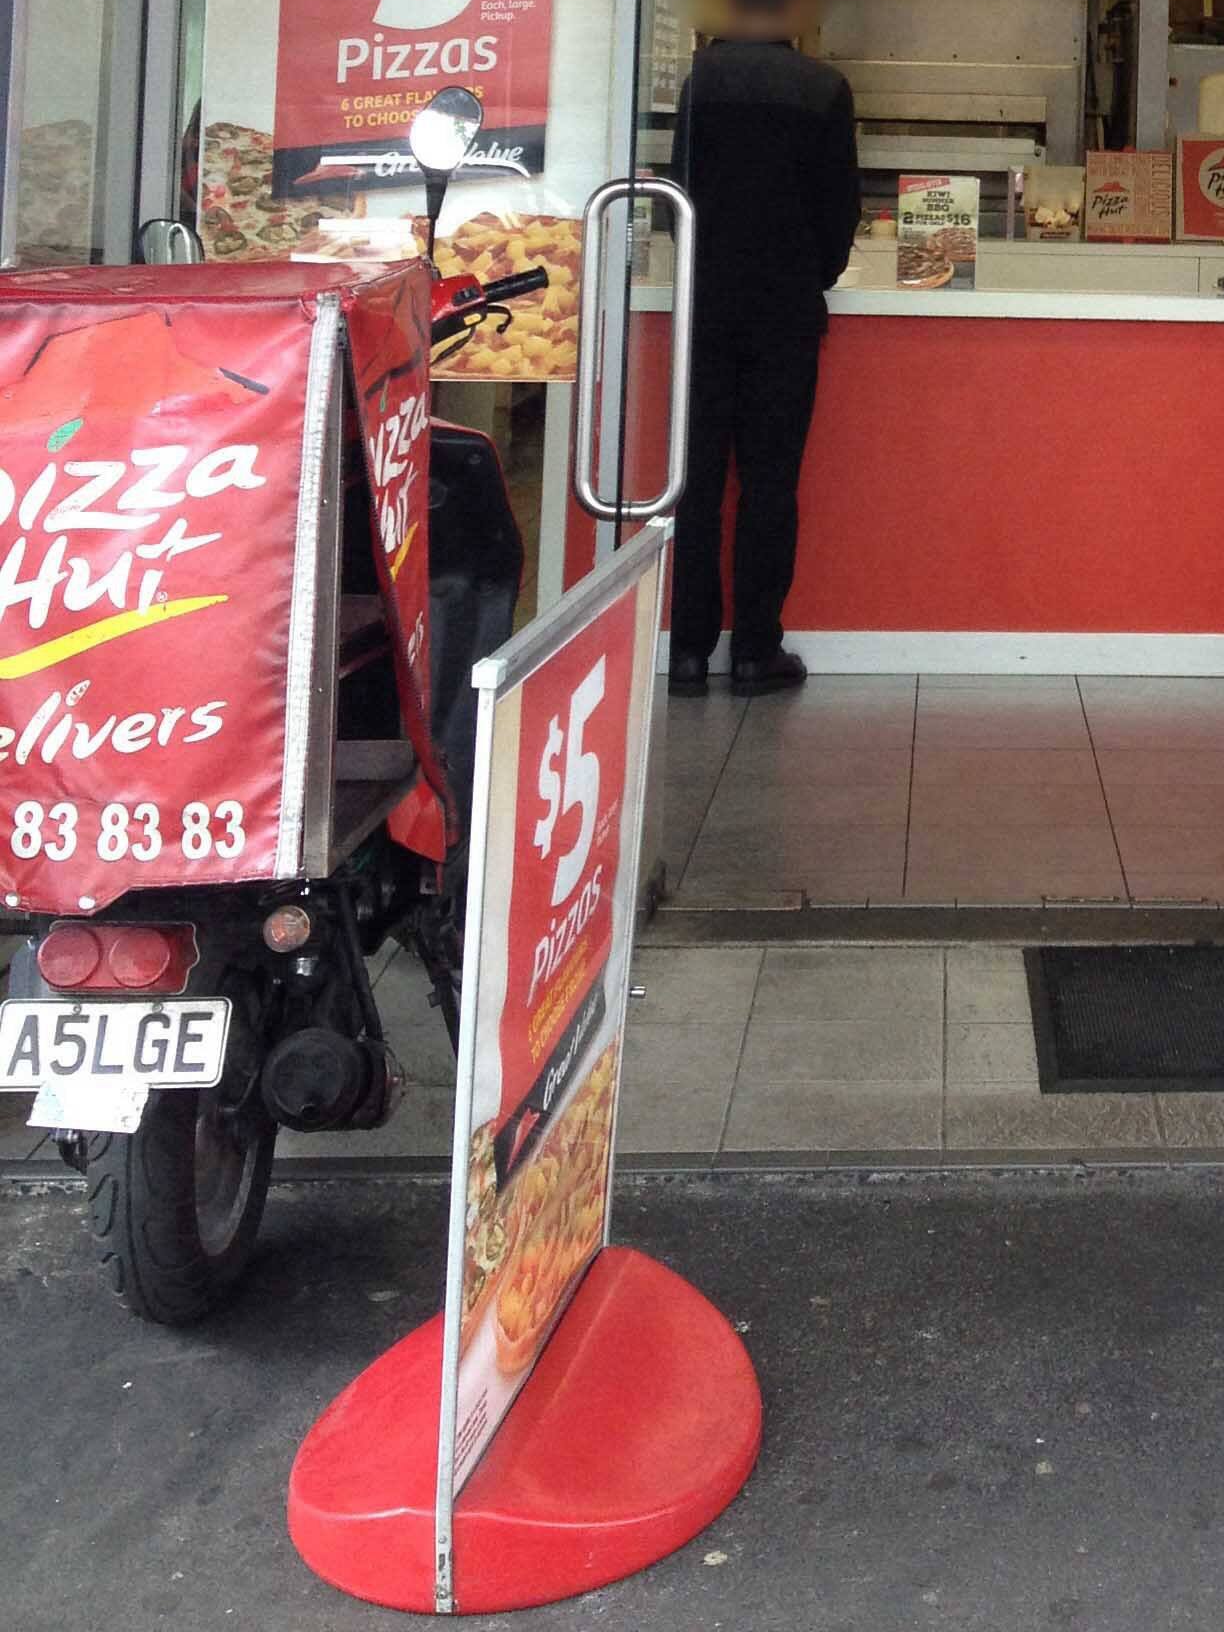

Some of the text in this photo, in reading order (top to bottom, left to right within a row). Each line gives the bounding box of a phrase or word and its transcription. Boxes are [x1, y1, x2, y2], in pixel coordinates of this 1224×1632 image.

[336, 32, 499, 84] Pizzas
[340, 98, 350, 111] 6
[353, 93, 403, 110] GREAT
[343, 114, 364, 129] TO
[903, 211, 914, 225] 2
[1092, 193, 1129, 209] Pizza
[0, 418, 266, 533] izza
[532, 652, 606, 907] $5
[10, 799, 247, 863] 83 83 83
[526, 863, 603, 1010] Pizzas
[5, 1011, 214, 1078] A5LGE
